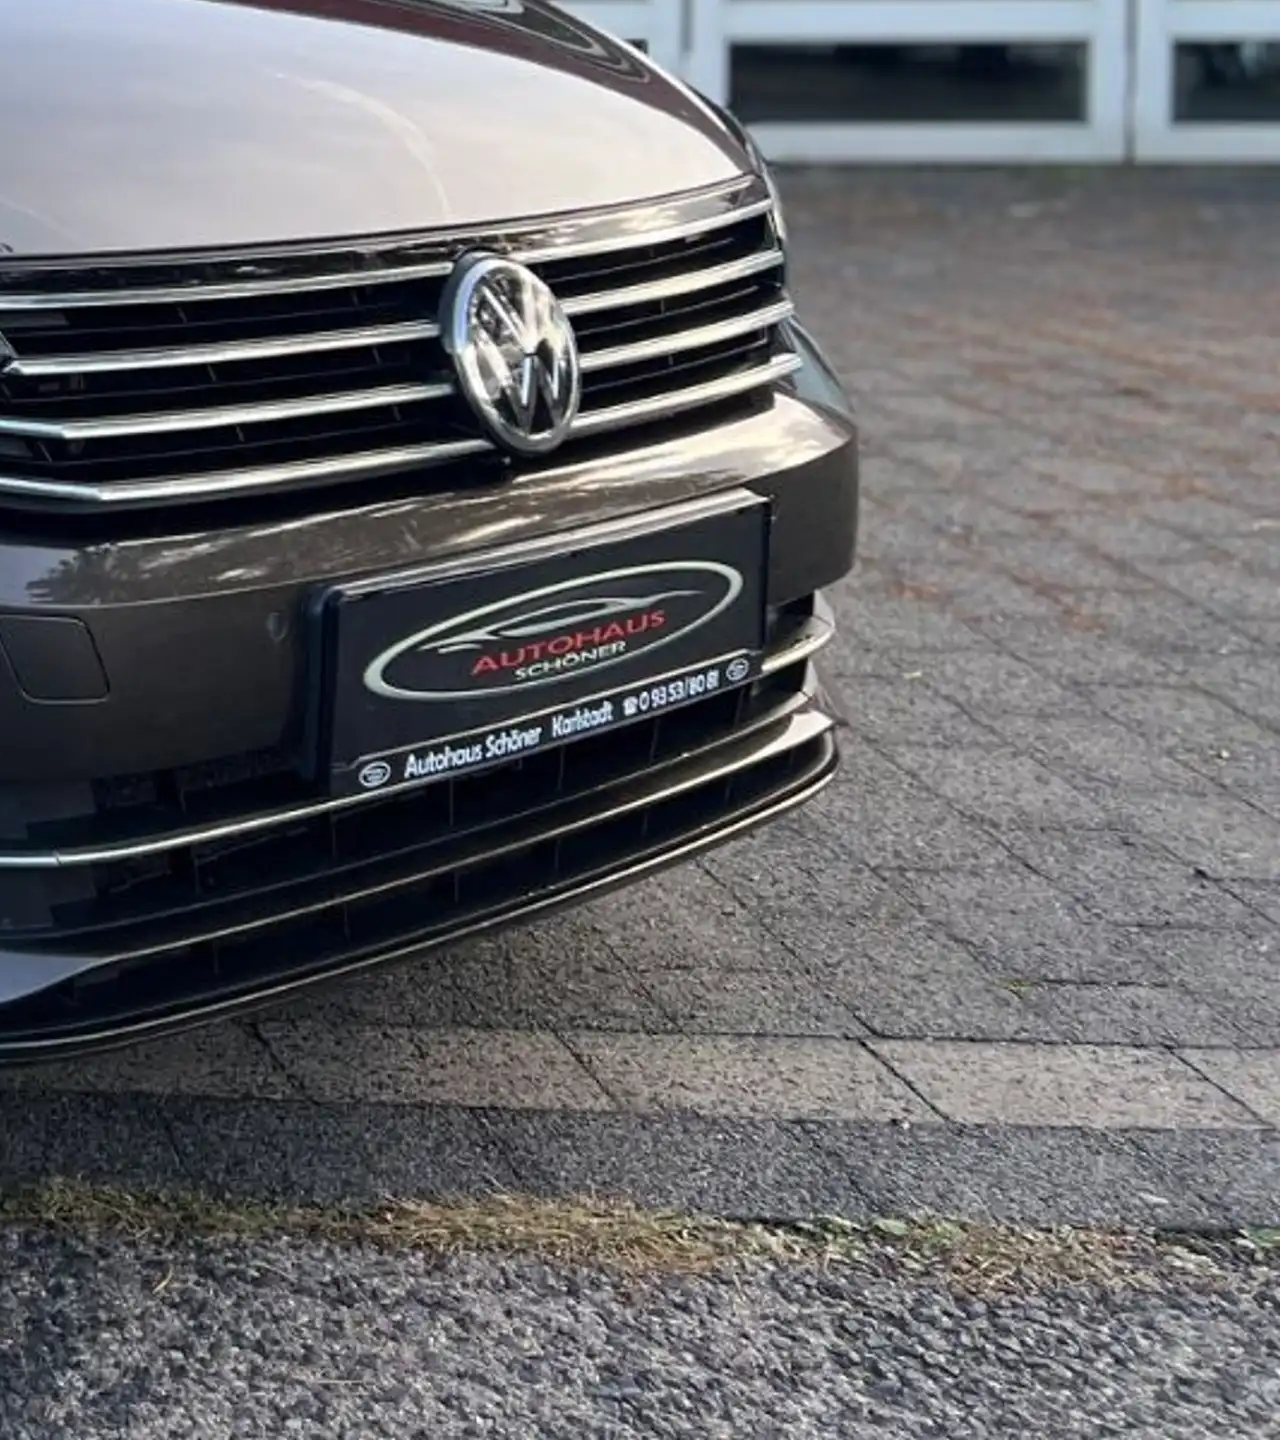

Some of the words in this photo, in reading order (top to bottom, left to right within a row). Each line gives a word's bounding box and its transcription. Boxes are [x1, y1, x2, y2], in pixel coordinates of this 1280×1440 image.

[471, 609, 666, 677] AUTOHAUS
[514, 640, 626, 680] SCHÖNER
[404, 743, 483, 779] Autohaus
[485, 726, 542, 757] Schöner
[552, 700, 614, 738] Karlstadt
